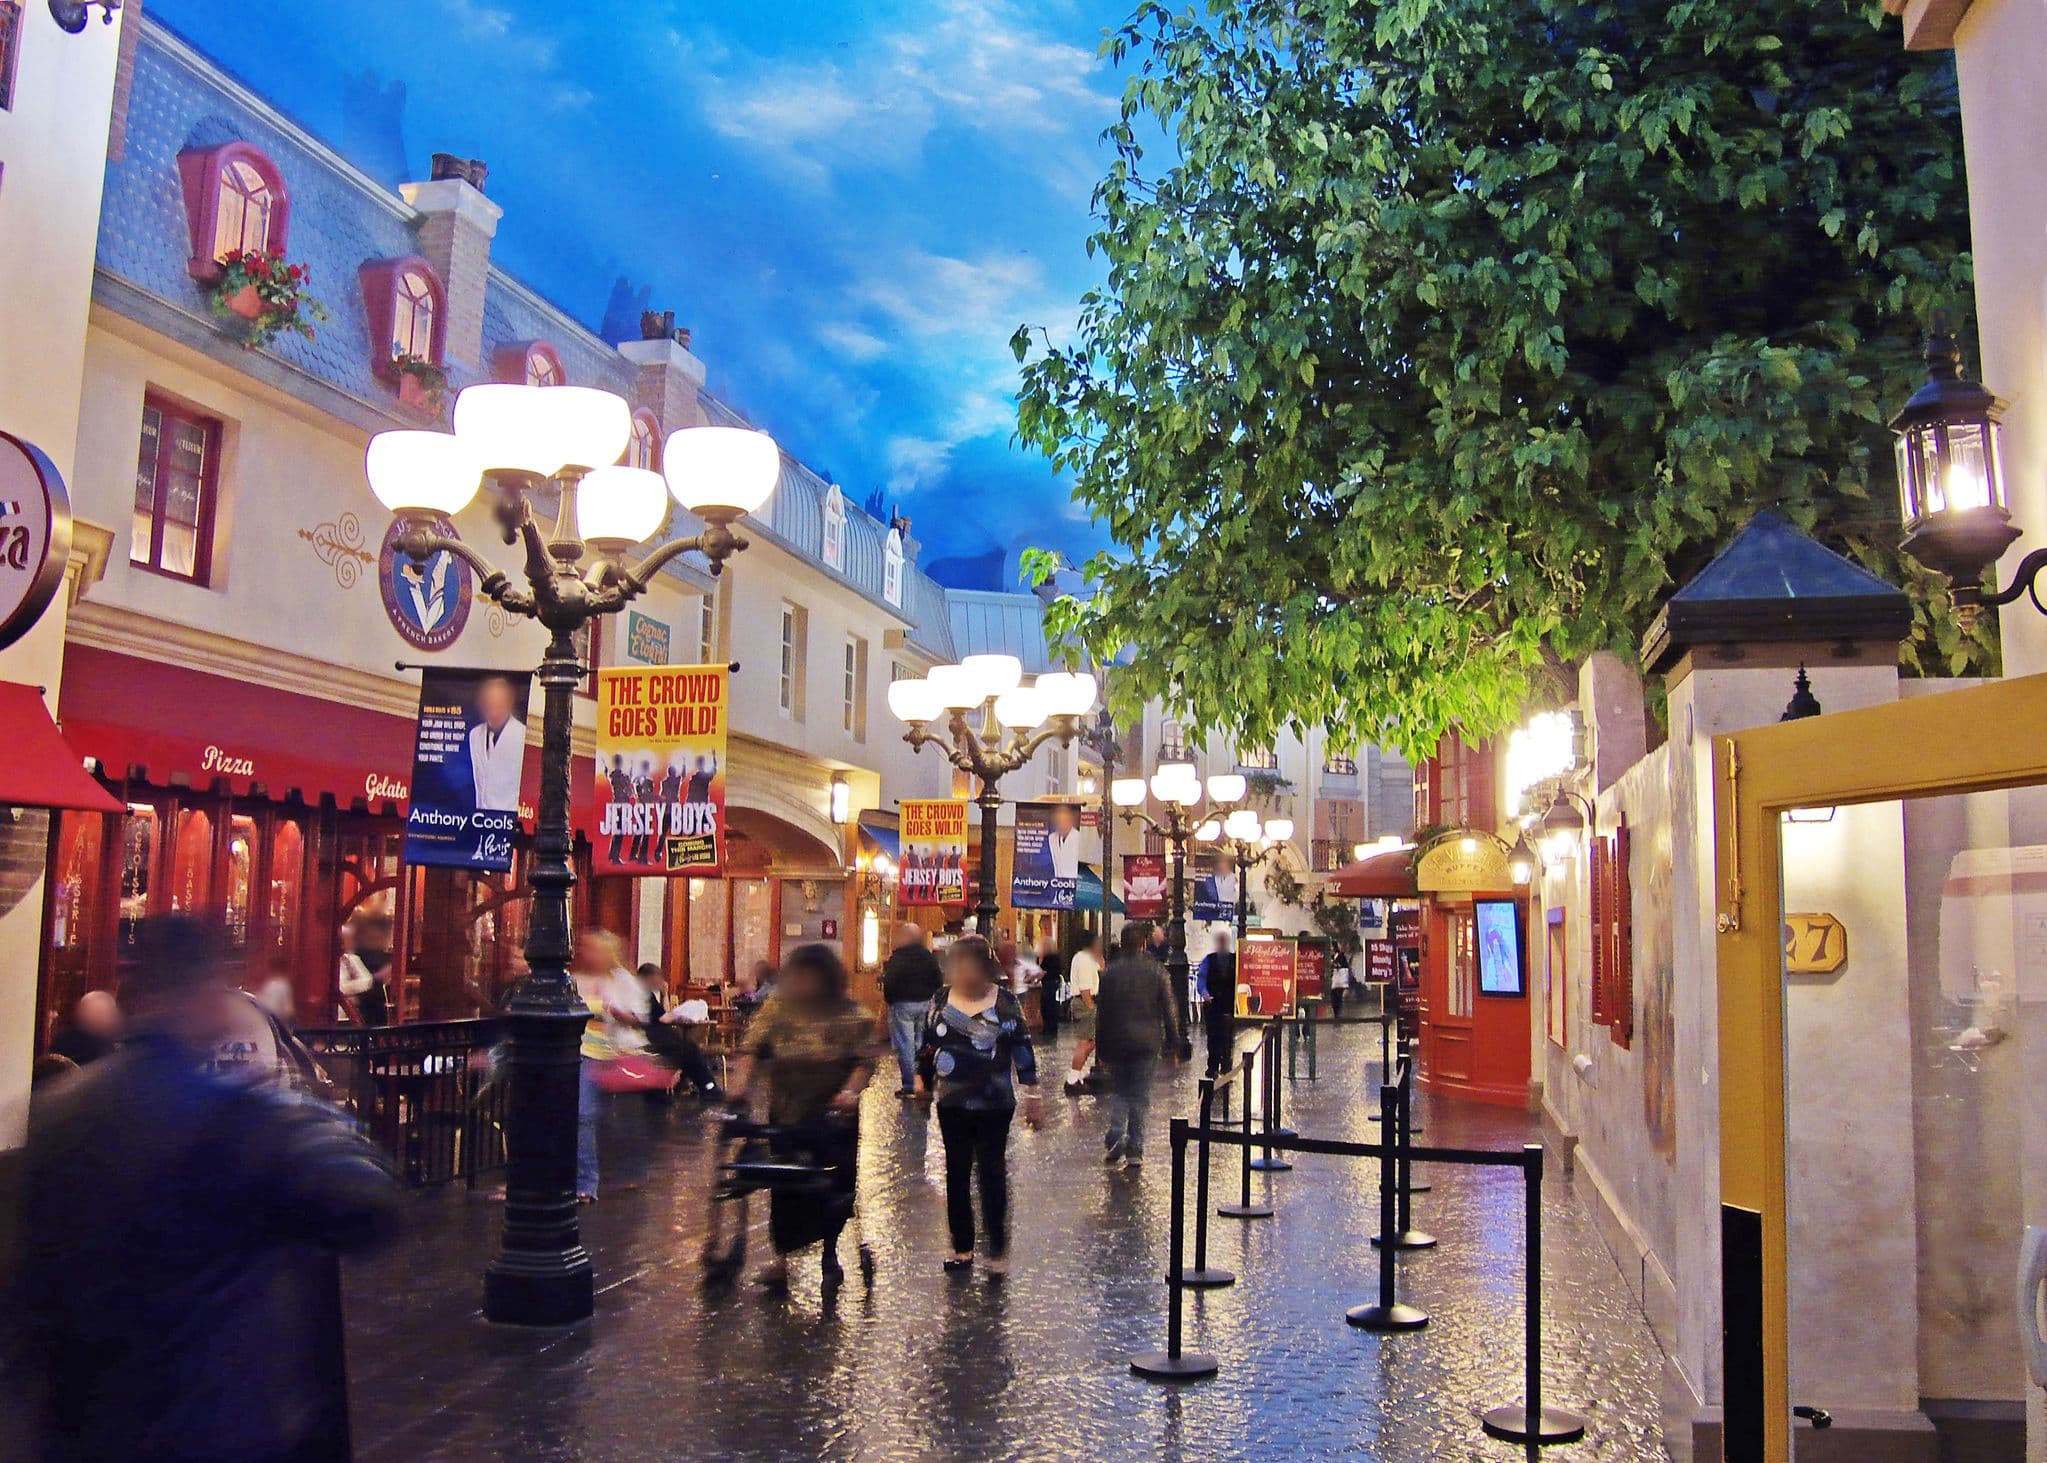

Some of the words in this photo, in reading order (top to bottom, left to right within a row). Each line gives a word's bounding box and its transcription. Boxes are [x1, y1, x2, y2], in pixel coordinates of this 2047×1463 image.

[398, 617, 426, 643] FRENCH
[635, 615, 667, 643] Cognac
[649, 674, 720, 705] CROWD
[608, 706, 658, 737] GOES
[202, 744, 255, 776] Pizza
[365, 773, 408, 802] Gelato
[409, 808, 467, 831] Anthony
[471, 812, 514, 830] Cools
[599, 803, 667, 836] JERSEY
[670, 801, 718, 836] BOYS
[904, 804, 923, 820] THE
[927, 804, 964, 820] CROWD
[906, 821, 932, 836] GOES
[935, 821, 962, 836] WILD!
[484, 833, 512, 857] Paris
[902, 868, 937, 885] JERSEY
[939, 867, 963, 885] BOYS
[1013, 877, 1049, 889] Anthony
[1050, 879, 1076, 889] Cools
